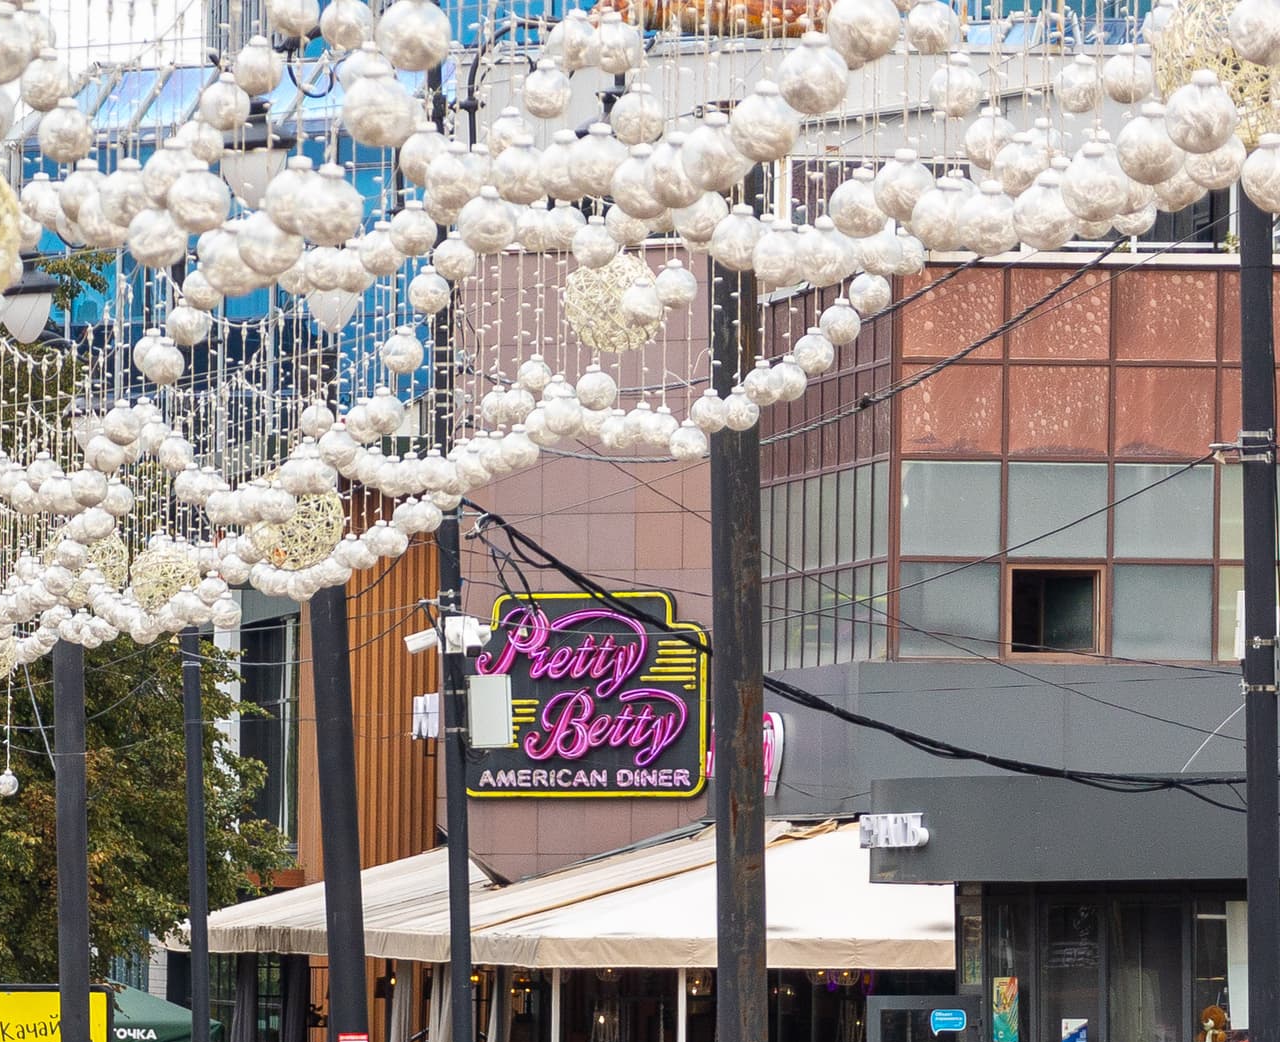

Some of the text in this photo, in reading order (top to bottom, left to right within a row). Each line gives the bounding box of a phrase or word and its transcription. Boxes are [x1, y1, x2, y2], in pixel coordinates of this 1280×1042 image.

[476, 606, 648, 698] Pretty
[524, 687, 688, 767] Betty
[478, 767, 692, 790] AMERICAN DINER
